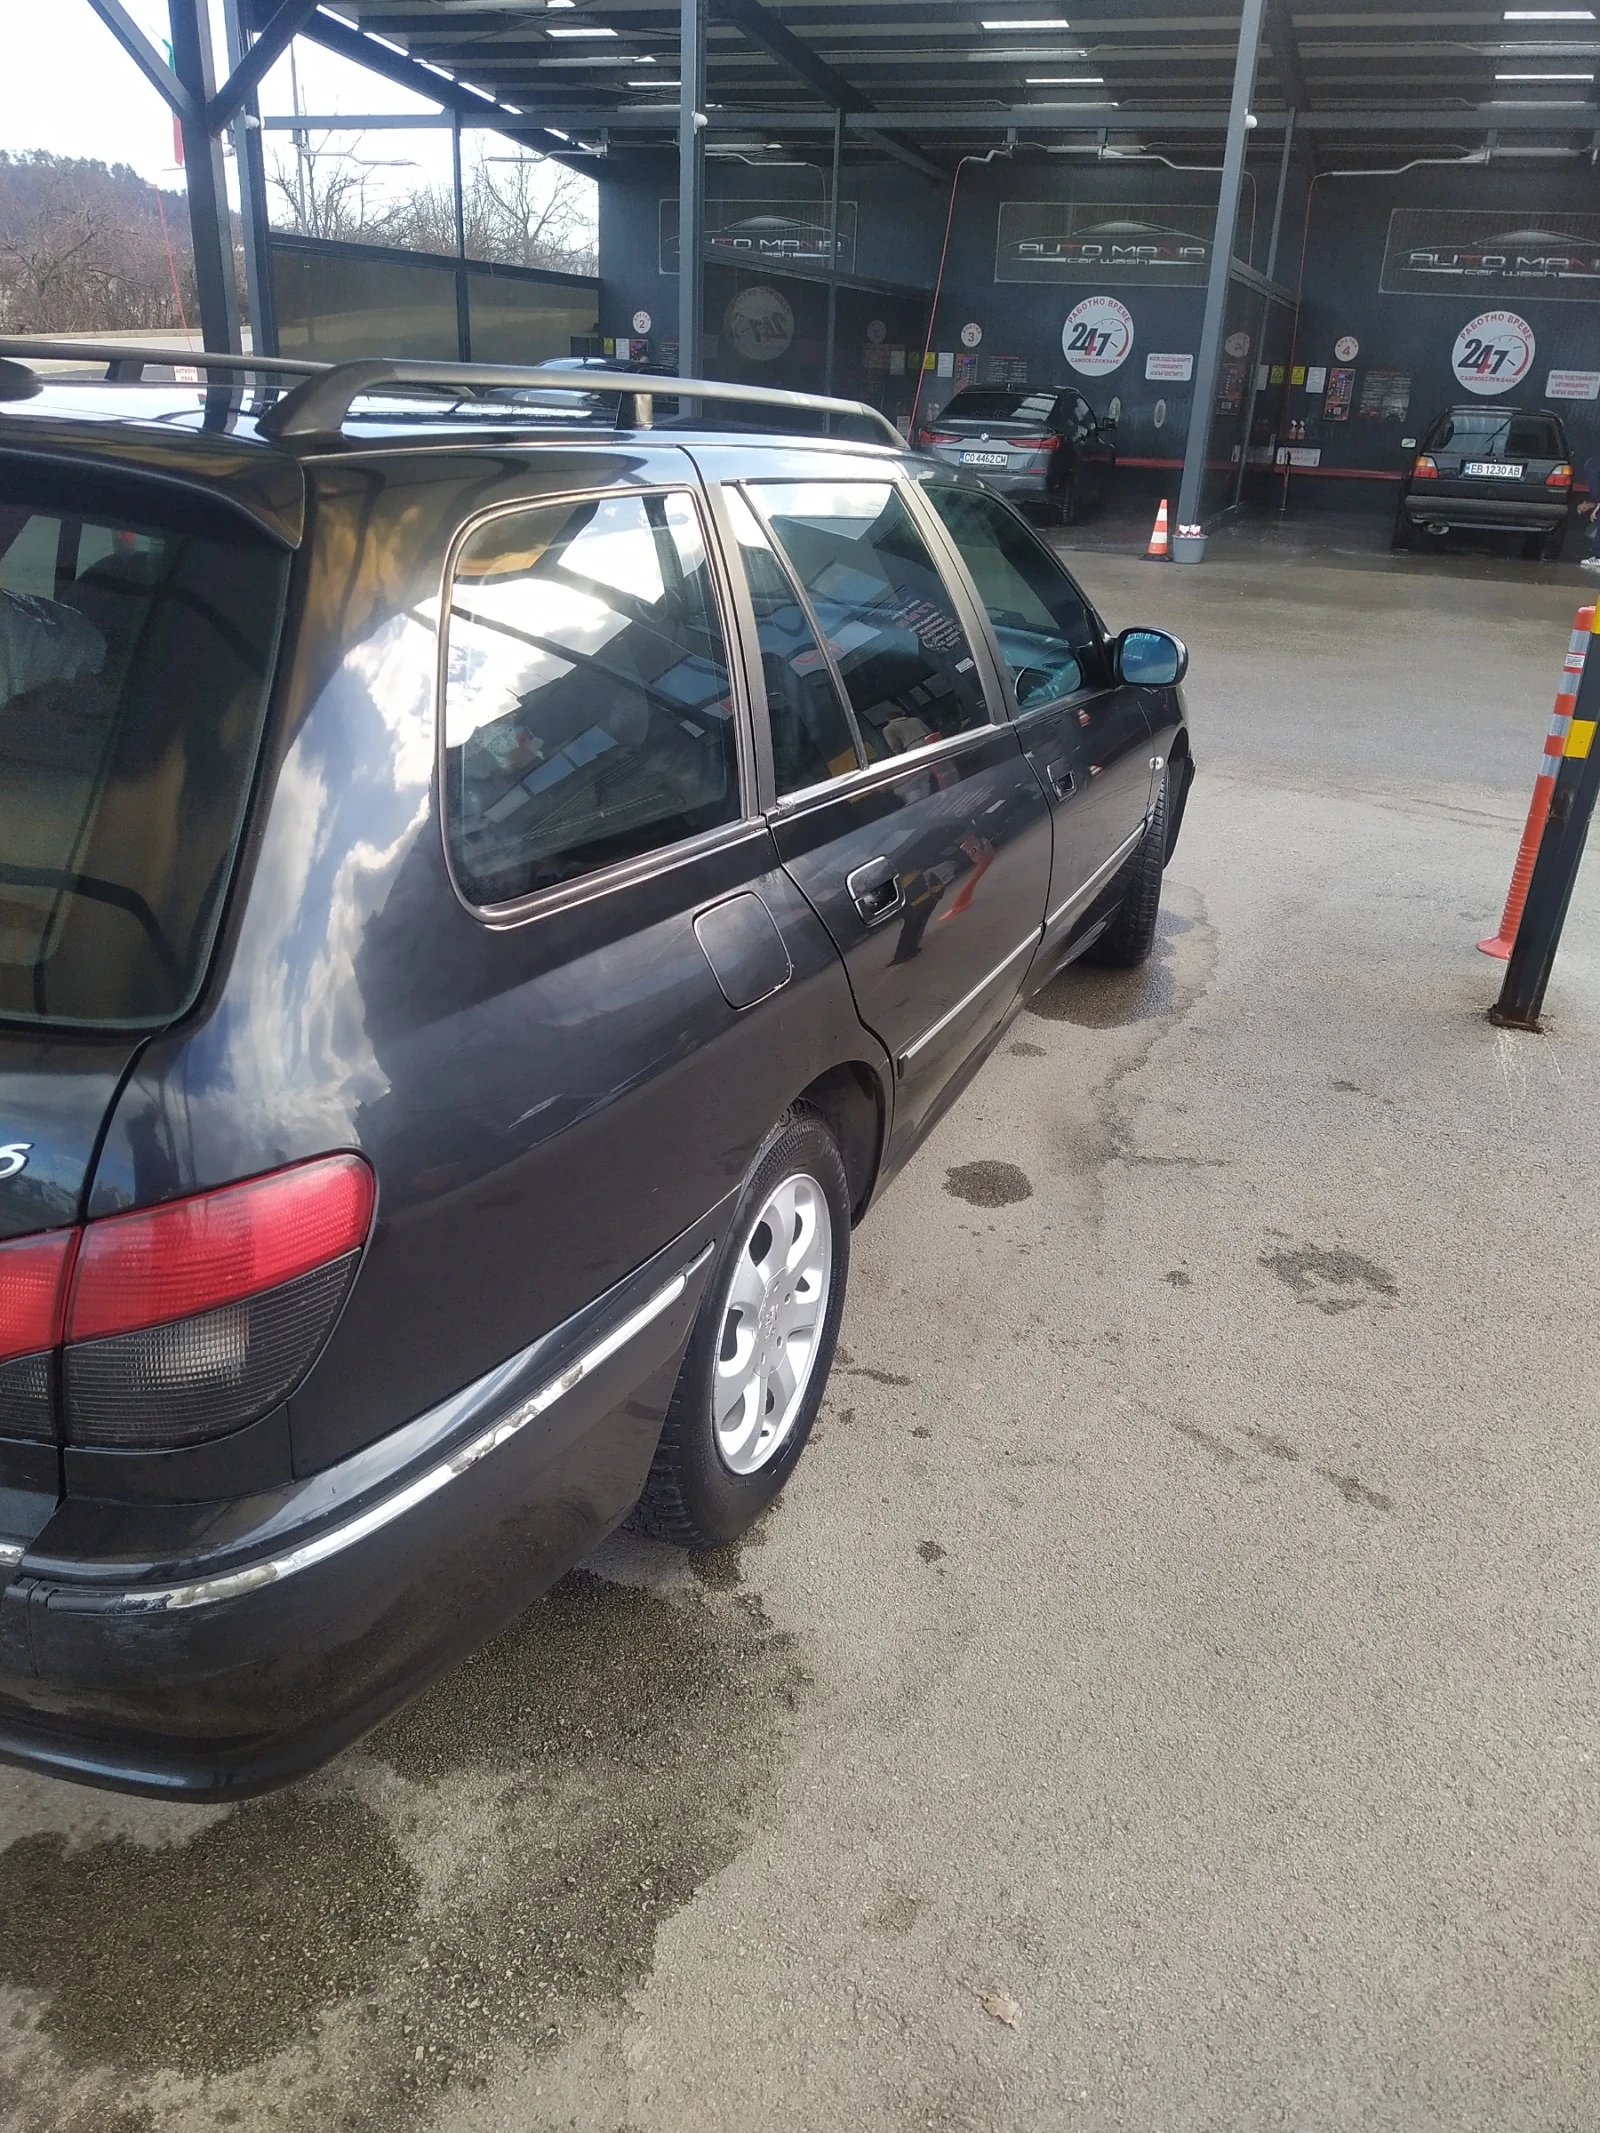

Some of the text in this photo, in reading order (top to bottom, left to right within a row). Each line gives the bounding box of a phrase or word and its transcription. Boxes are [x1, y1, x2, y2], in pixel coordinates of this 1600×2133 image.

[1018, 243, 1206, 258] AUTO MANIA
[1409, 253, 1507, 268] AUTO
[1067, 298, 1131, 325] РАБОТНО ВРЕМЕ
[639, 319, 646, 329] 2
[1460, 313, 1533, 342] РАБОТНО ВРЕМЕ
[967, 331, 975, 342] 3
[1341, 345, 1352, 357] 4
[964, 453, 975, 462] CO
[975, 454, 996, 464] 4462
[1470, 464, 1521, 476] EB 1230 AB
